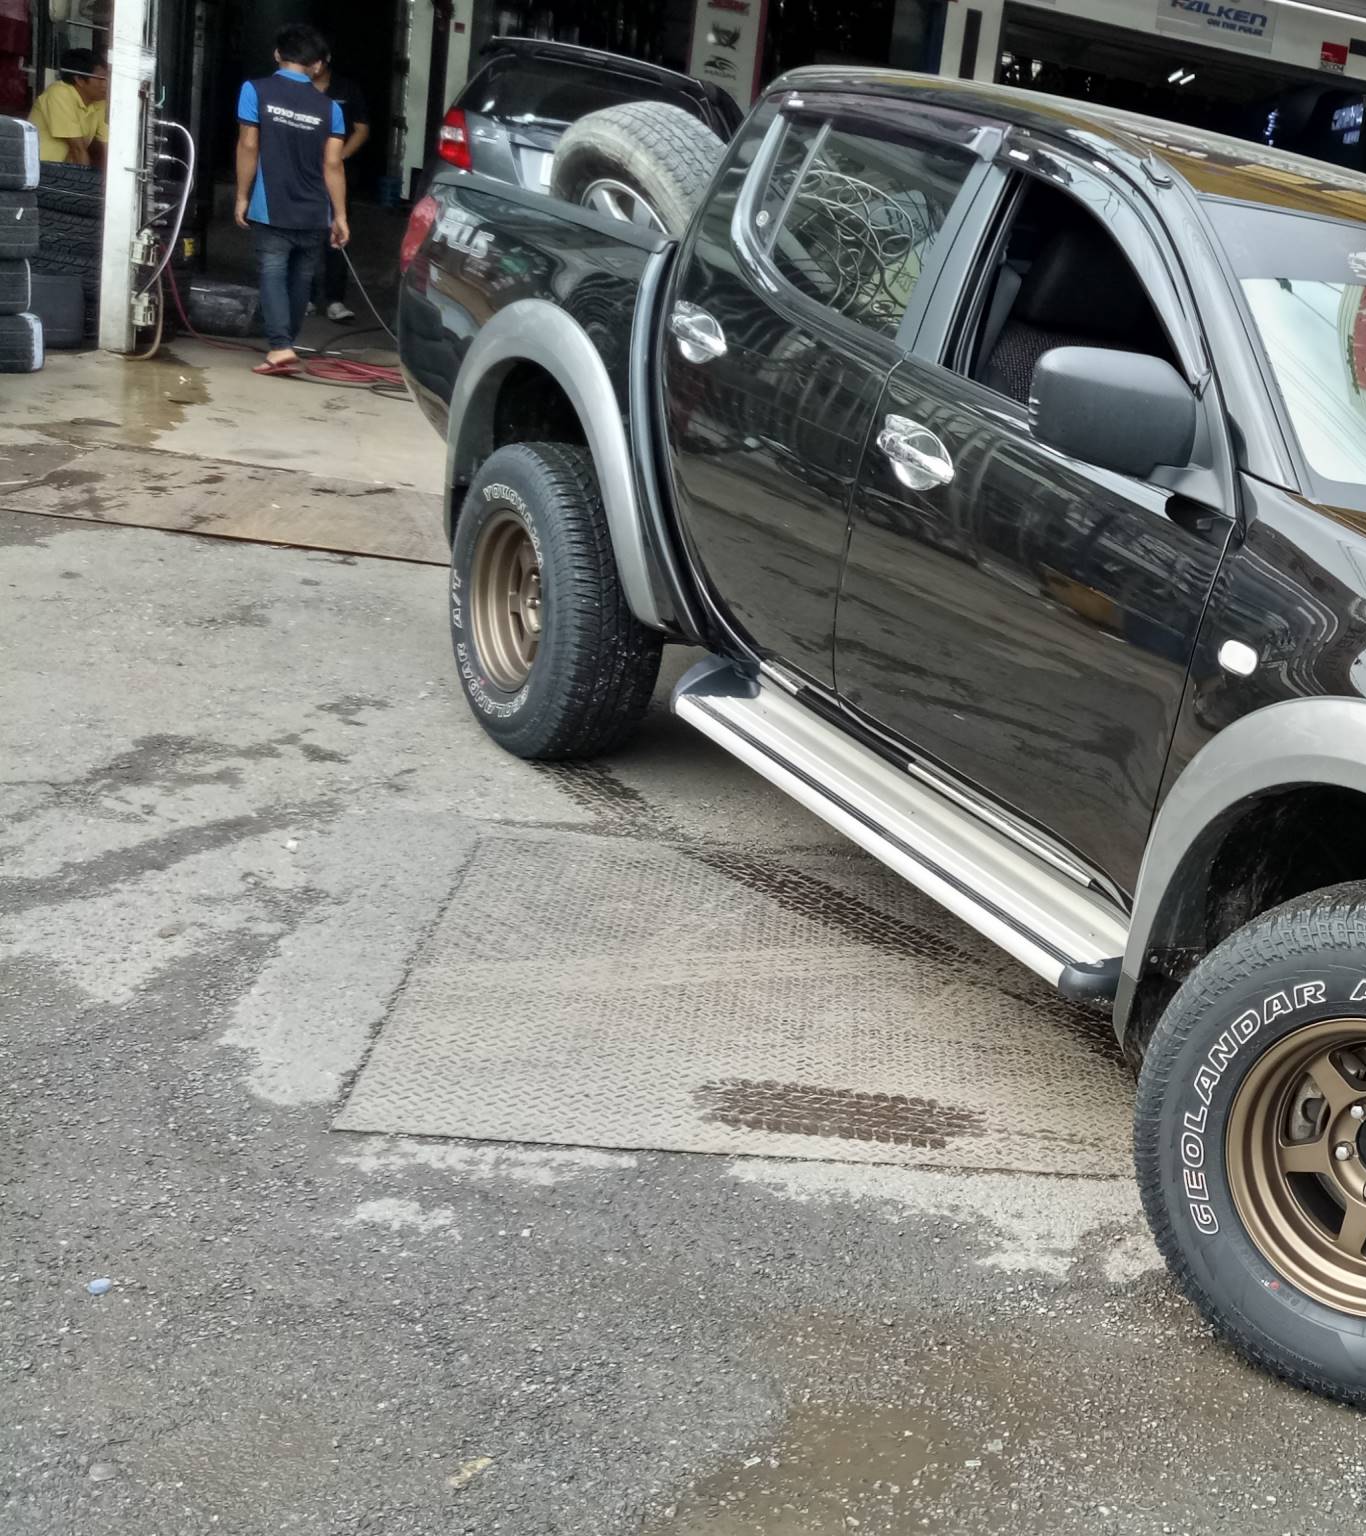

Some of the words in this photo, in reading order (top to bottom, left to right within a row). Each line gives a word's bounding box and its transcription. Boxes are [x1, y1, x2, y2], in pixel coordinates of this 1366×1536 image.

[1171, 0, 1267, 27] FALKEN
[483, 482, 544, 569] YOKOHAMA
[1178, 980, 1327, 1236] GEOLANDAR
